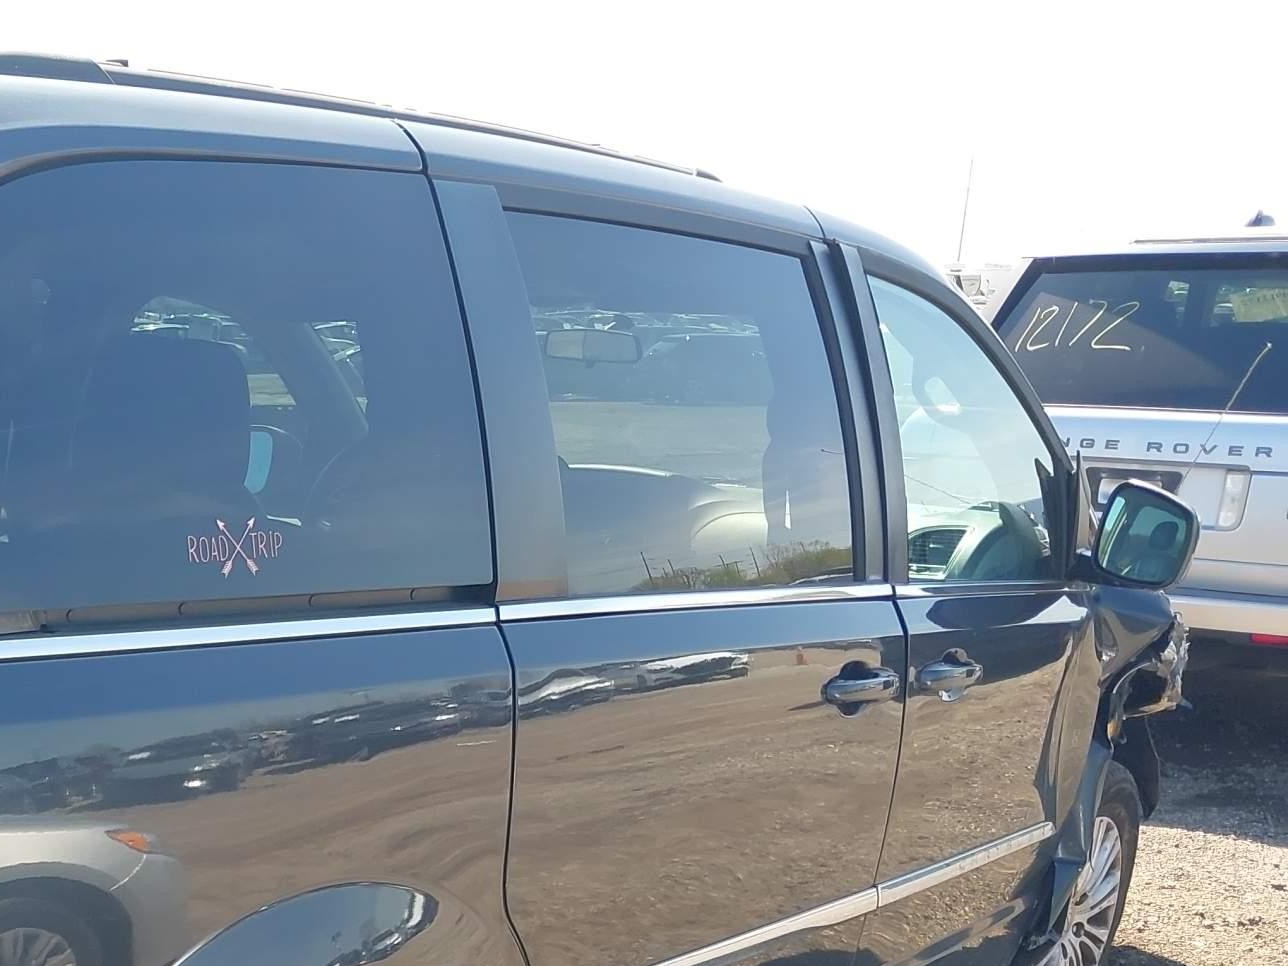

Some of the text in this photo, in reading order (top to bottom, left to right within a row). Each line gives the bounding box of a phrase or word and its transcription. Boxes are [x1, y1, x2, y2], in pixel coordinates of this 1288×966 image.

[1014, 299, 1140, 353] 12172
[1146, 441, 1273, 458] ROVER
[187, 531, 283, 563] ROAD TRIP
